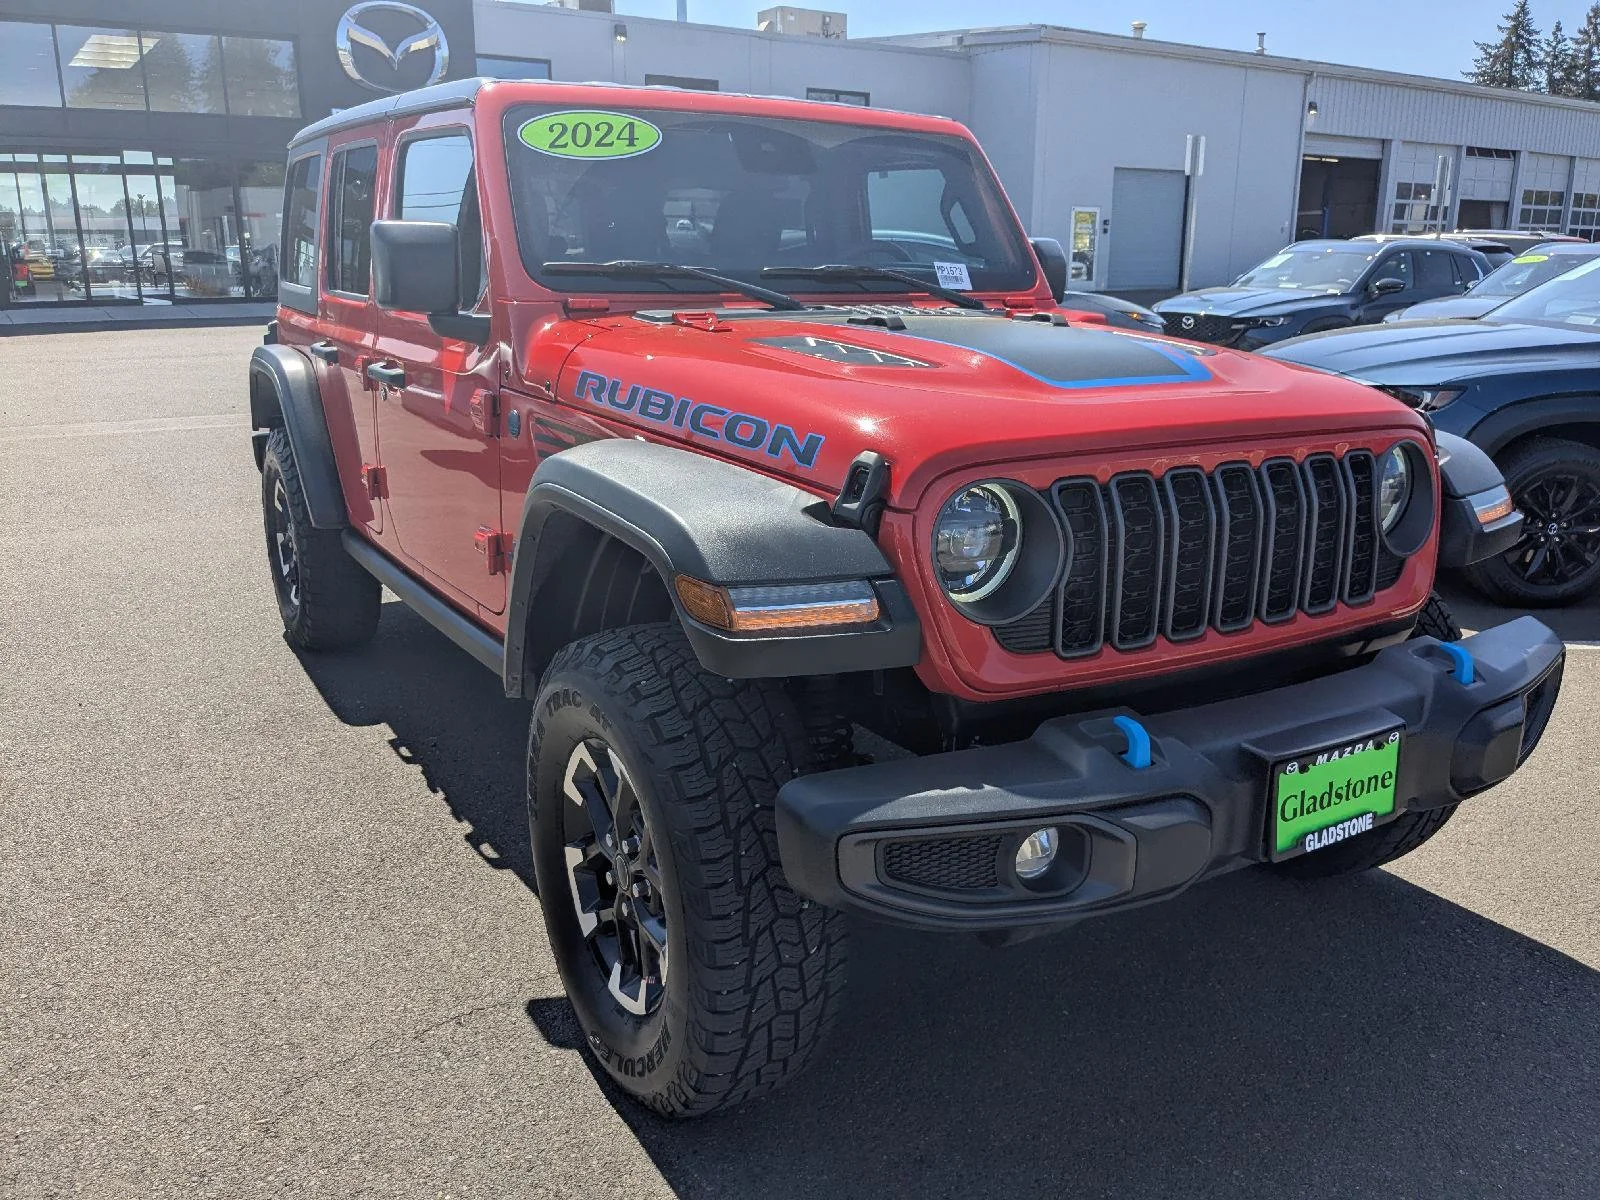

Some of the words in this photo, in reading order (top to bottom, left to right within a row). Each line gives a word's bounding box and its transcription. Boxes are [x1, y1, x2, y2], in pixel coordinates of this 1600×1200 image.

[548, 121, 639, 148] 2024
[574, 369, 826, 468] RUBICON
[545, 688, 582, 718] TRAC
[1316, 740, 1375, 765] MAZDA
[1280, 770, 1393, 823] Gladstone
[1305, 813, 1373, 853] GLADSTONE
